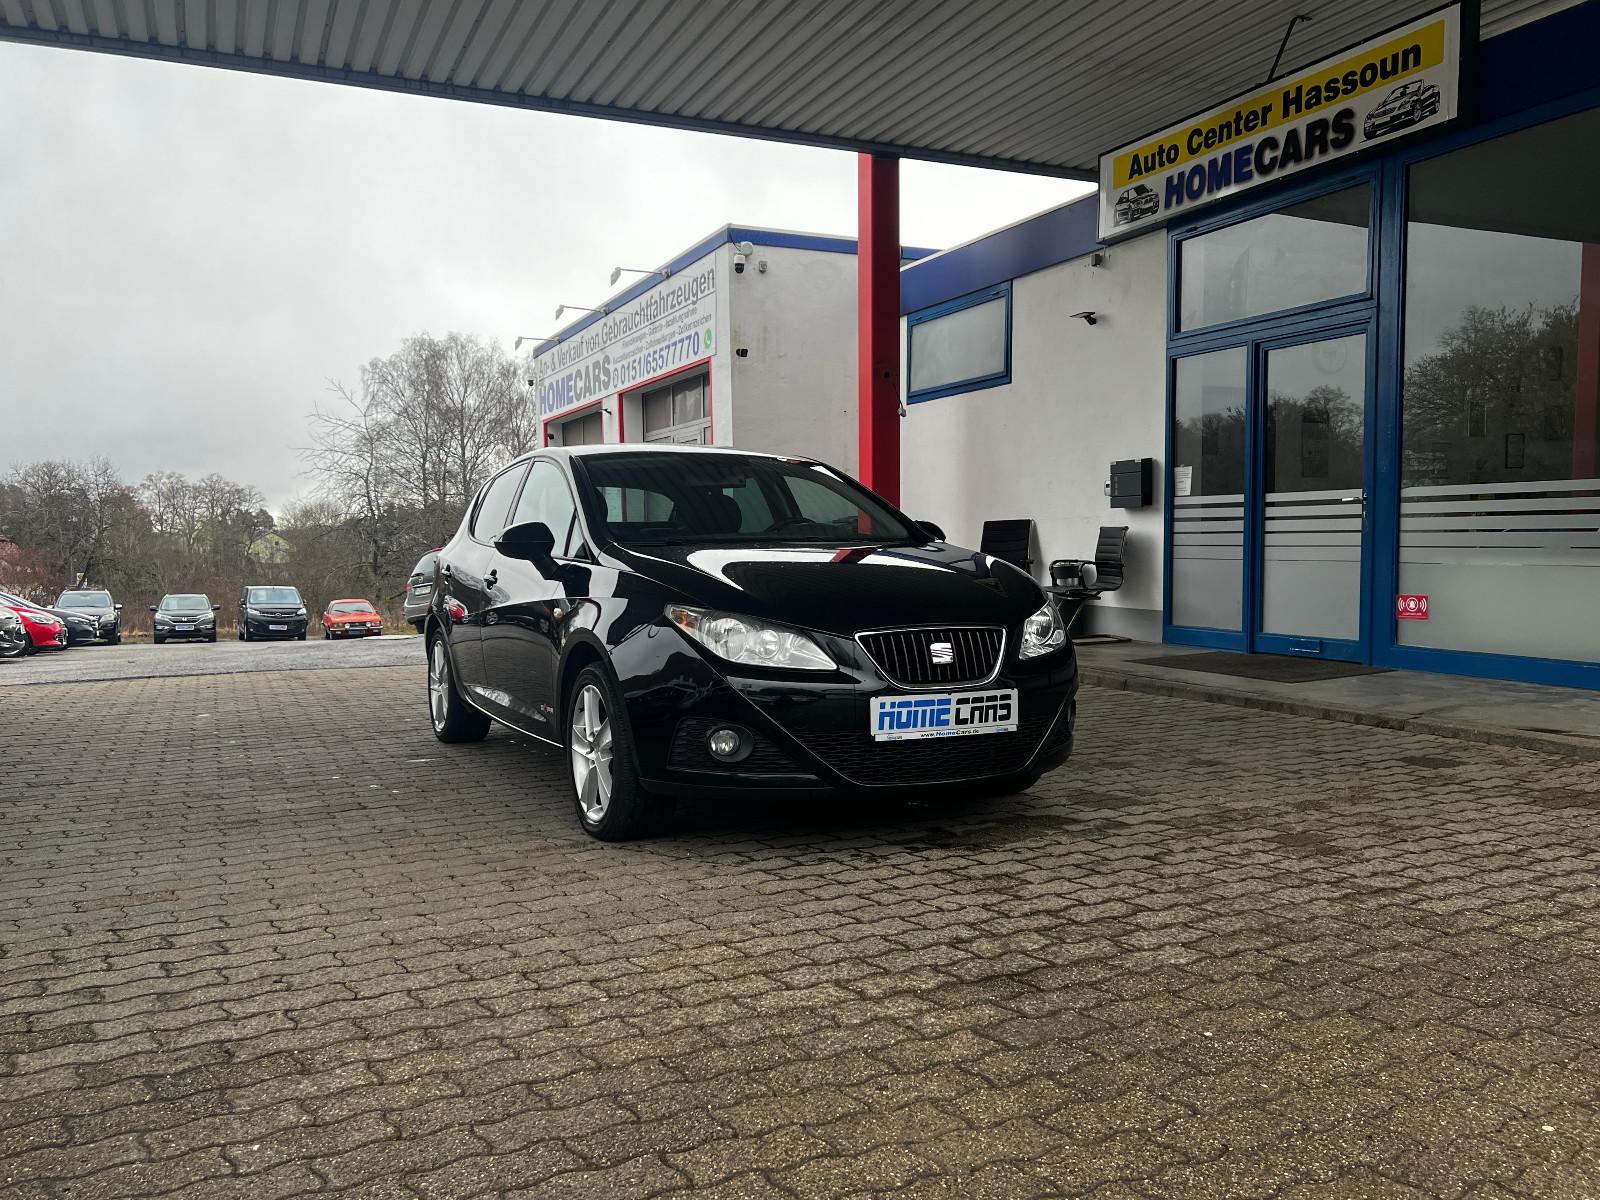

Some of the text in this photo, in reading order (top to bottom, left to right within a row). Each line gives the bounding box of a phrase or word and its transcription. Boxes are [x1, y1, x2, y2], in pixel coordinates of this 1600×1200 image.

[1128, 43, 1422, 180] Auto Center Hassoun
[1164, 108, 1355, 209] HOMECARS
[558, 336, 584, 369] Verkauf
[585, 332, 600, 354] von
[601, 267, 715, 345] Gebrauchtfahrzeugen
[620, 331, 700, 385] 0151/65577770
[539, 354, 611, 416] HOMECARS
